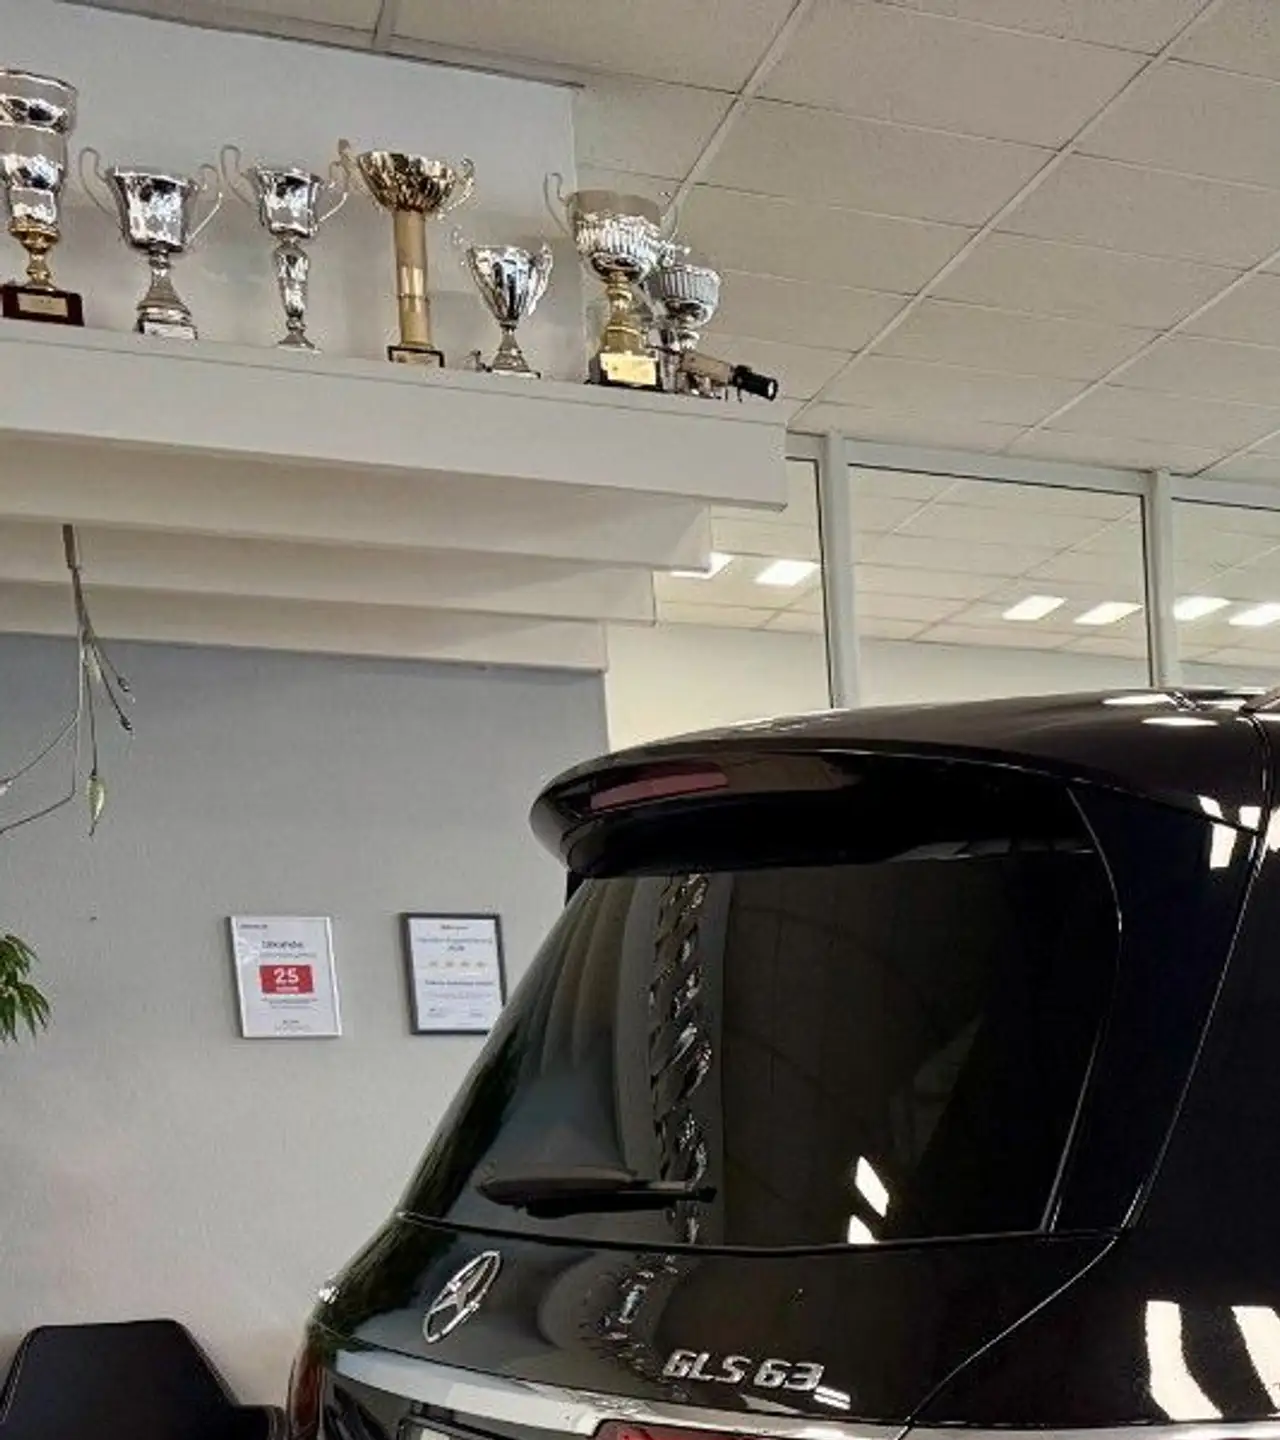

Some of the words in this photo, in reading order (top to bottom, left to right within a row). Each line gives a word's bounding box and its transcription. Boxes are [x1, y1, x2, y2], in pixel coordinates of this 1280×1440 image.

[272, 967, 300, 985] 25
[661, 1348, 752, 1385] GLS
[752, 1358, 826, 1392] 63
